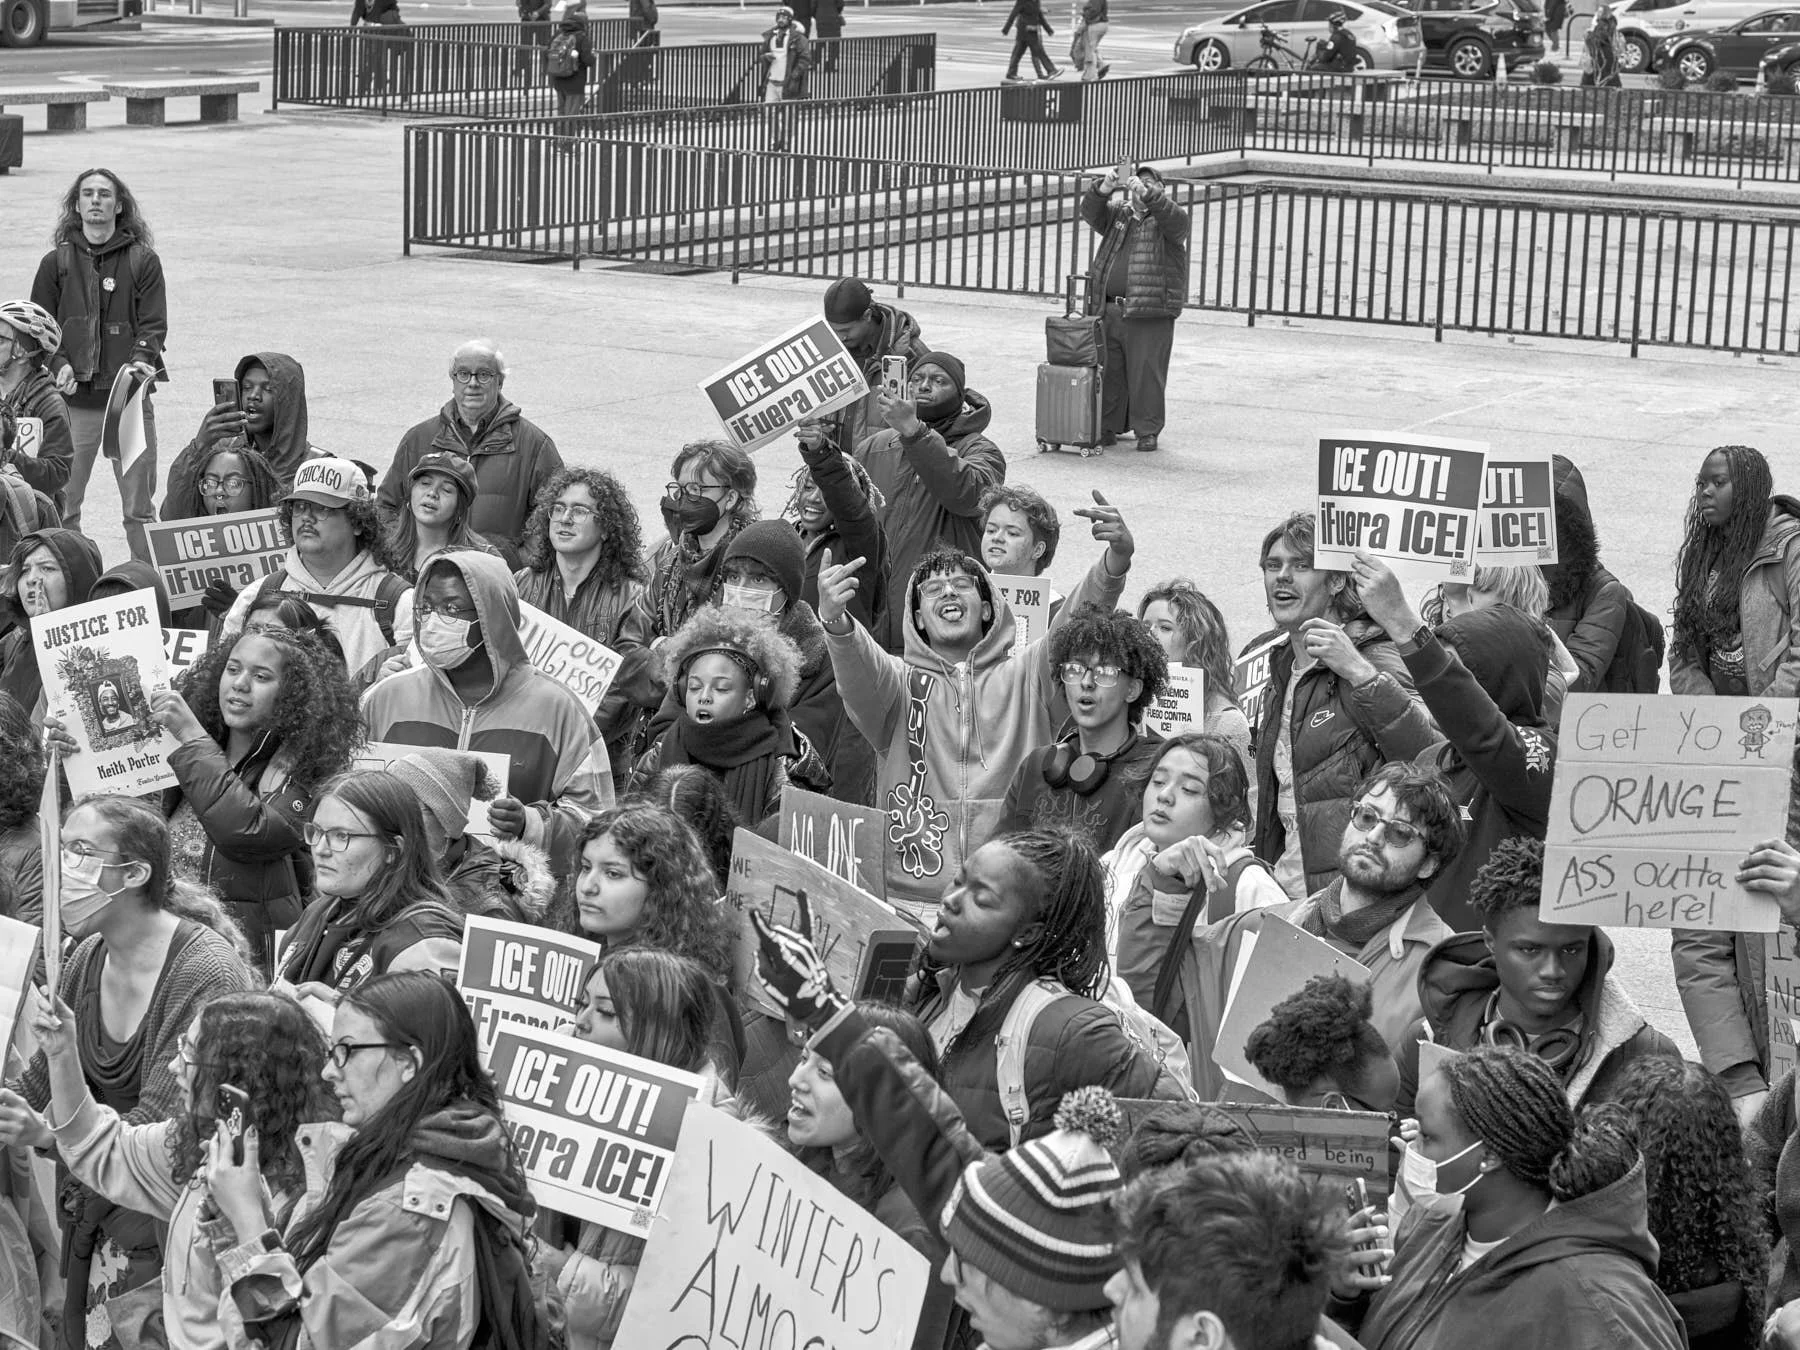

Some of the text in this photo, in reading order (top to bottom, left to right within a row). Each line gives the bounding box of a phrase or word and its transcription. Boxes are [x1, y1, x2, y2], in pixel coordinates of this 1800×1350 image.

[726, 334, 824, 408] ICE OUT!
[730, 356, 857, 444] ¡Fuera ICE!
[297, 464, 342, 490] CHICAGO
[1332, 447, 1451, 501] ICE OUT!
[1483, 467, 1524, 504] UT!
[173, 519, 286, 561] ICE OUT!
[1321, 501, 1390, 550] ¡Fuera
[1399, 508, 1469, 559] ICE!
[1491, 512, 1548, 548] ICE!
[1015, 588, 1041, 607] FOR
[44, 605, 150, 650] JUSTICE FOR
[1164, 710, 1192, 723] CONTRA
[1575, 703, 1647, 751] Get
[97, 760, 126, 780] Keith
[127, 753, 160, 771] Porter
[1569, 774, 1742, 835] ORANGE
[1556, 854, 1615, 904] ASS
[490, 940, 583, 1008] ICE OUT!
[504, 1045, 662, 1137] ICE OUT!
[582, 1137, 665, 1207] ICE!
[1324, 1139, 1375, 1172] being
[707, 1138, 896, 1335] WINTER'S
